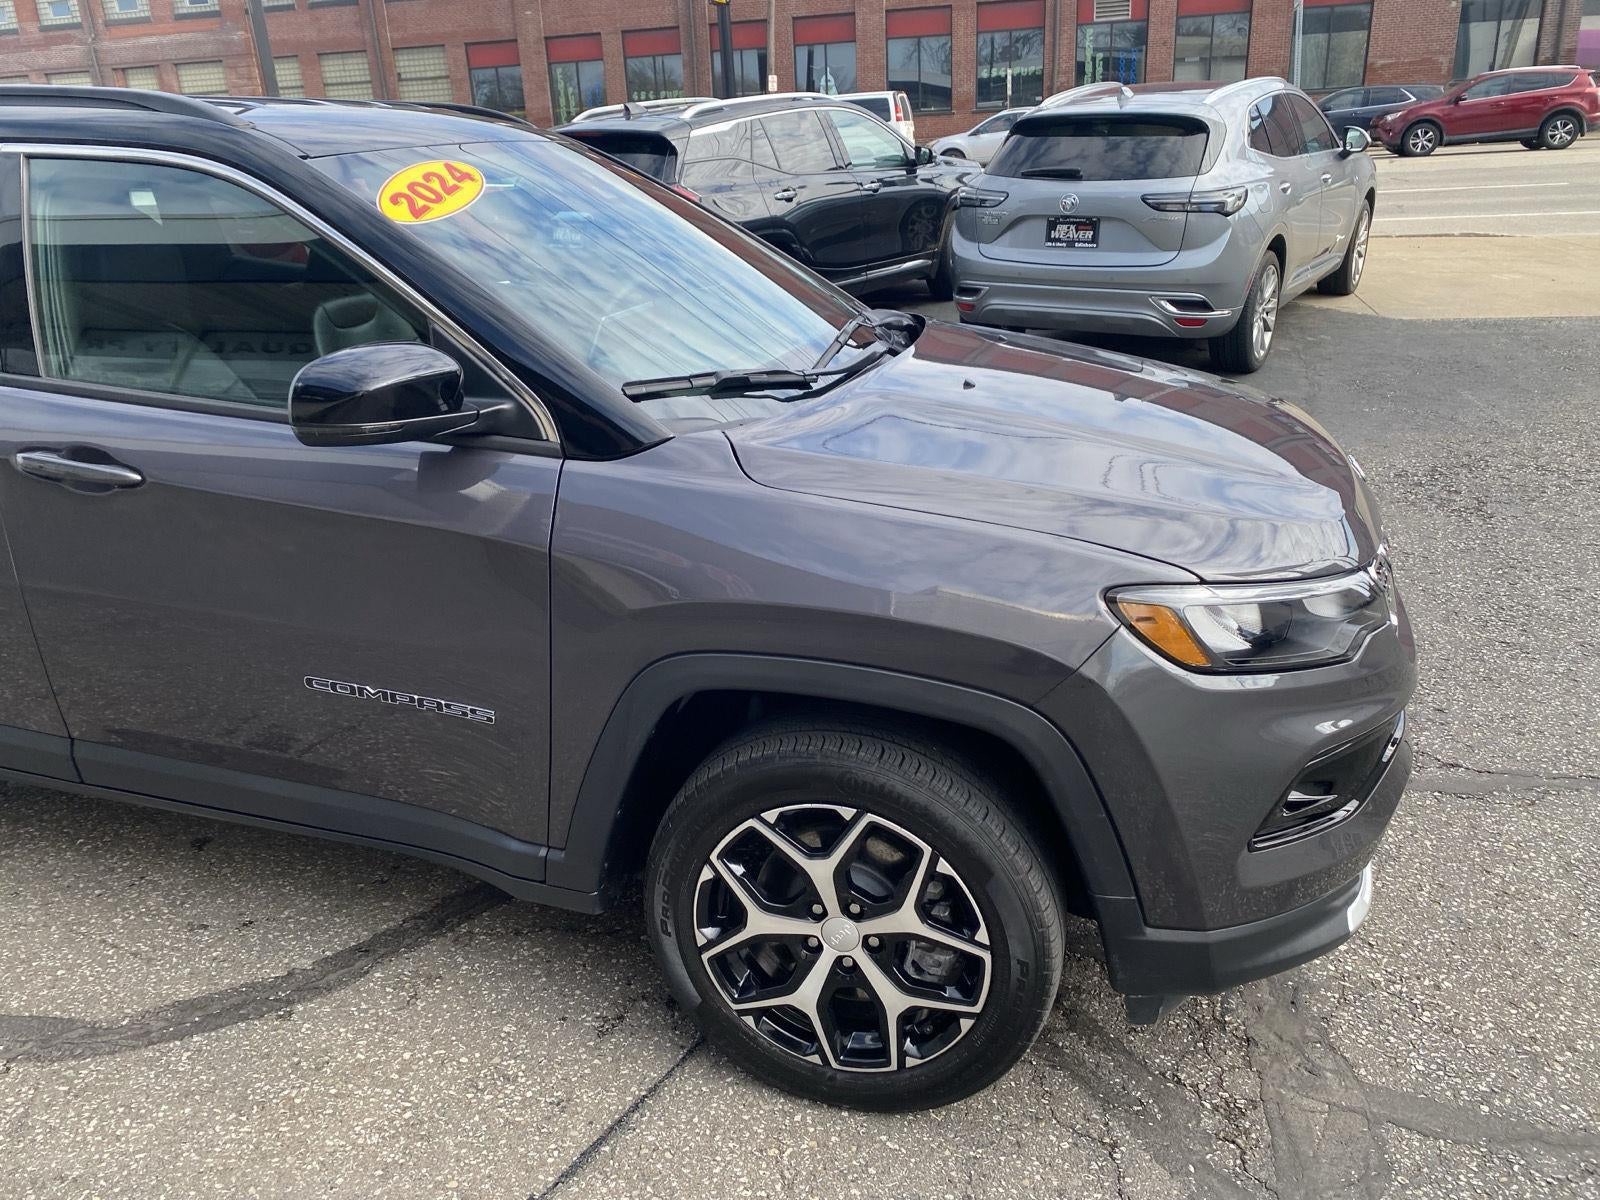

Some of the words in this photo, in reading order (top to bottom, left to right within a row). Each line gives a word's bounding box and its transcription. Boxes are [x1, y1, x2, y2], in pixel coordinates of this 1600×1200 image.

[390, 163, 476, 219] 2024
[1051, 230, 1093, 238] WEAVER
[304, 676, 495, 724] COMPASS
